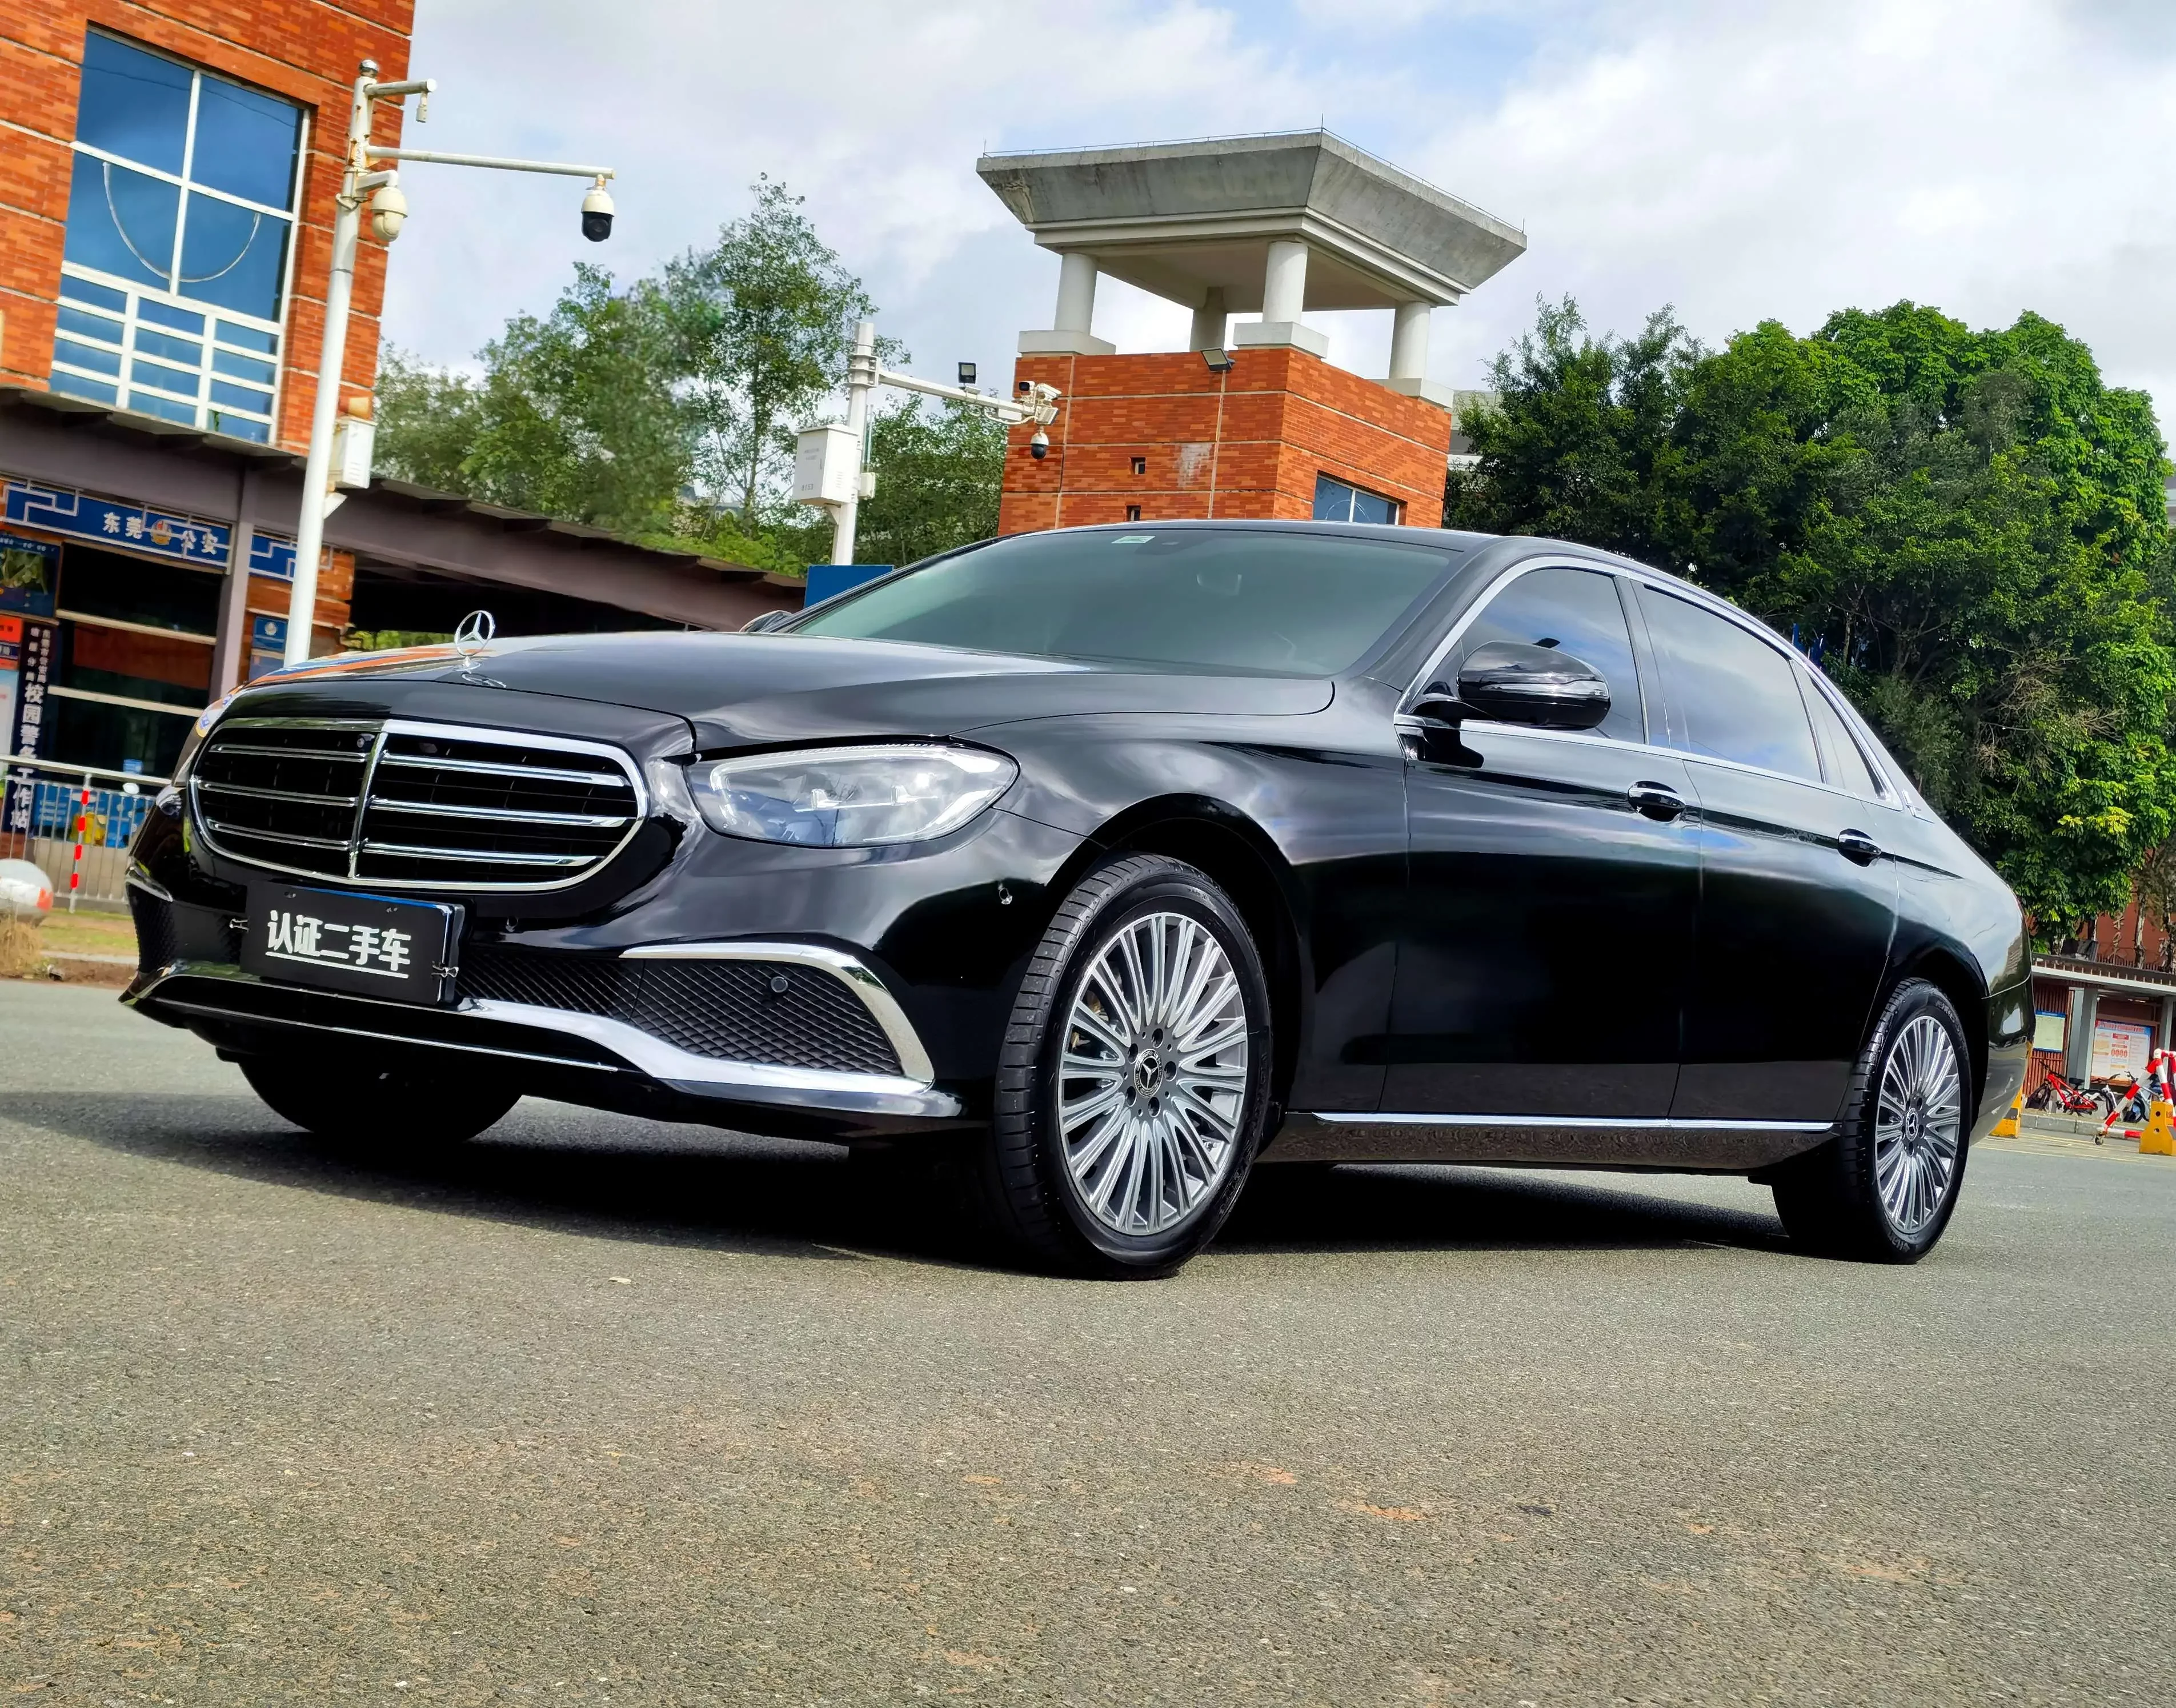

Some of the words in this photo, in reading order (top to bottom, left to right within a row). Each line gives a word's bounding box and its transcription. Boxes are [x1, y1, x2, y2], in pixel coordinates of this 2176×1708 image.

[267, 909, 411, 971] 认证二手车
